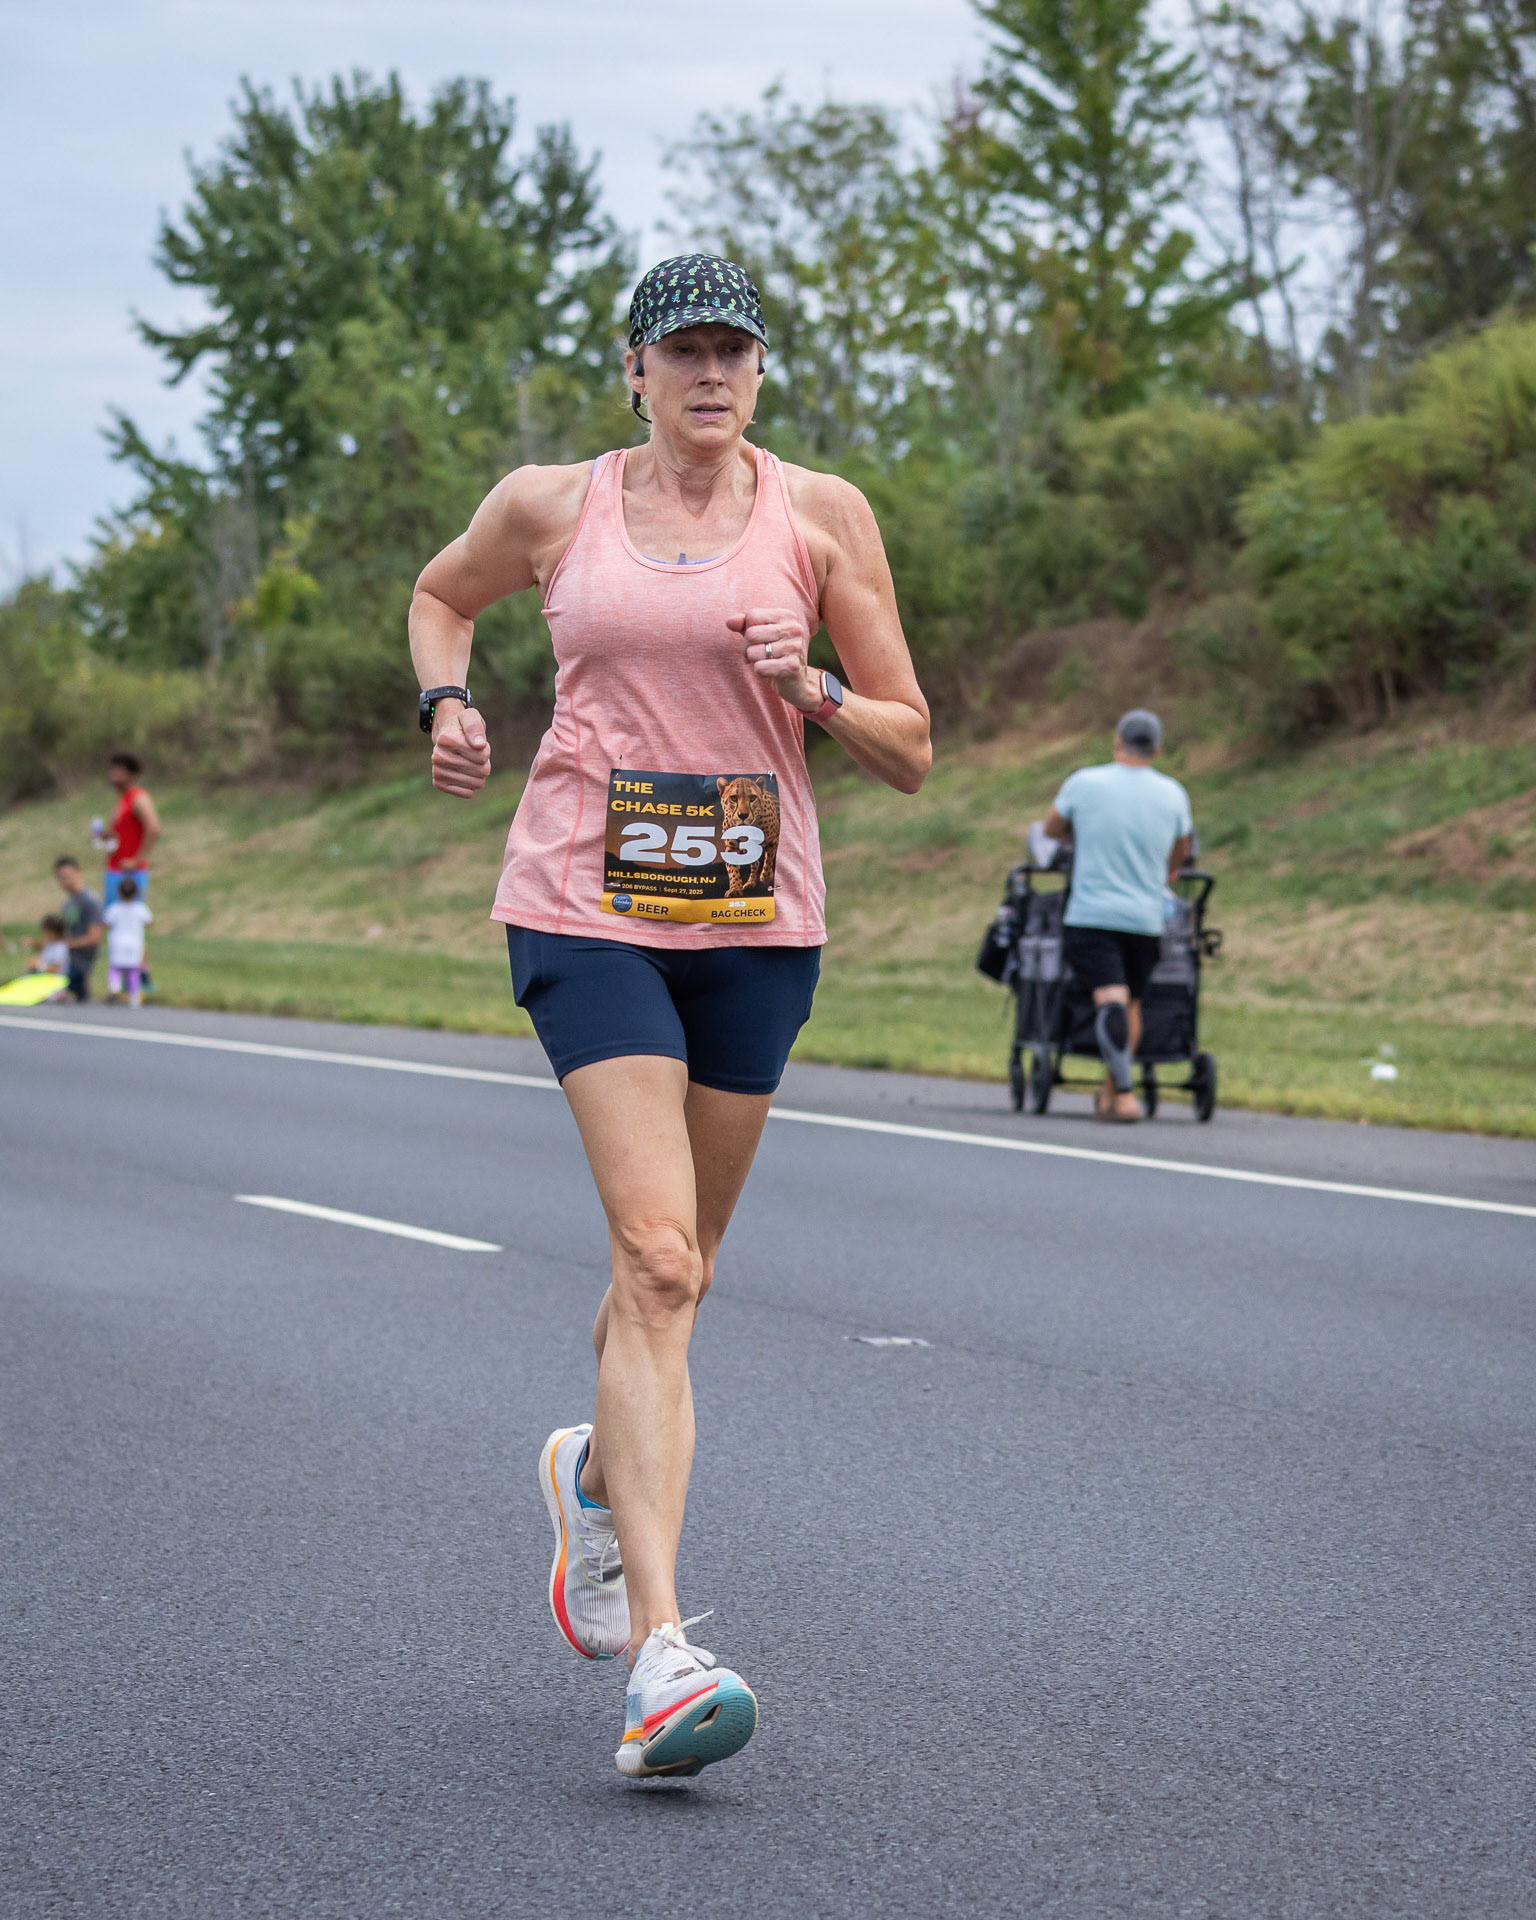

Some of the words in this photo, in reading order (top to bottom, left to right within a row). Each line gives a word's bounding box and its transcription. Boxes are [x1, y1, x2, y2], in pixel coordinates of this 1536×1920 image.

[613, 780, 653, 794] THE
[611, 800, 682, 815] CHASE
[685, 805, 715, 817] 5K
[619, 822, 765, 866] 253
[607, 870, 699, 884] HILLSBOROUGH,
[663, 886, 678, 894] Sept
[637, 902, 669, 915] BEER
[711, 909, 731, 918] BAG
[733, 908, 766, 917] CHECK
